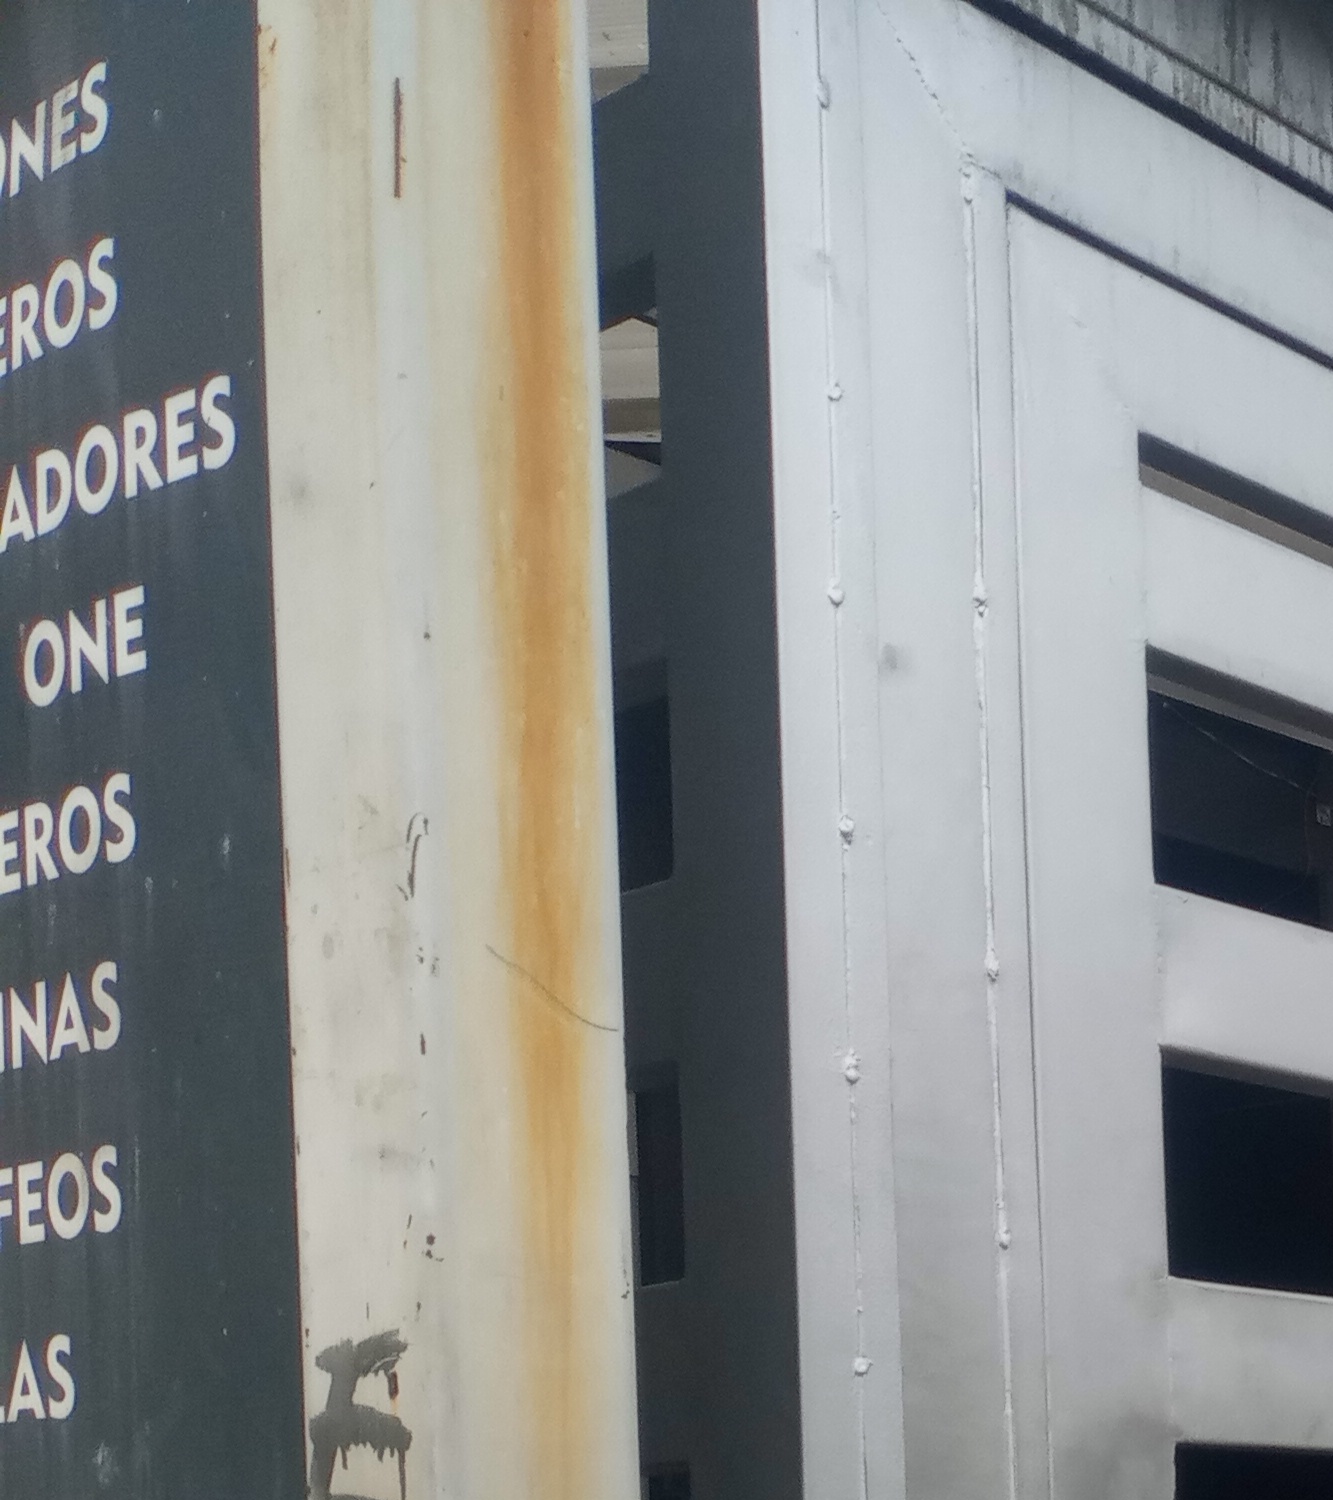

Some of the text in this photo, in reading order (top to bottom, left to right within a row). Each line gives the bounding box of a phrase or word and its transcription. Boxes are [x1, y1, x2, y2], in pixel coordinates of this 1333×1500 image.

[0, 60, 110, 198] NES
[0, 236, 119, 377] ROS
[0, 374, 237, 555] ADORES
[22, 584, 148, 708] ONE
[0, 1334, 76, 1424] AS
